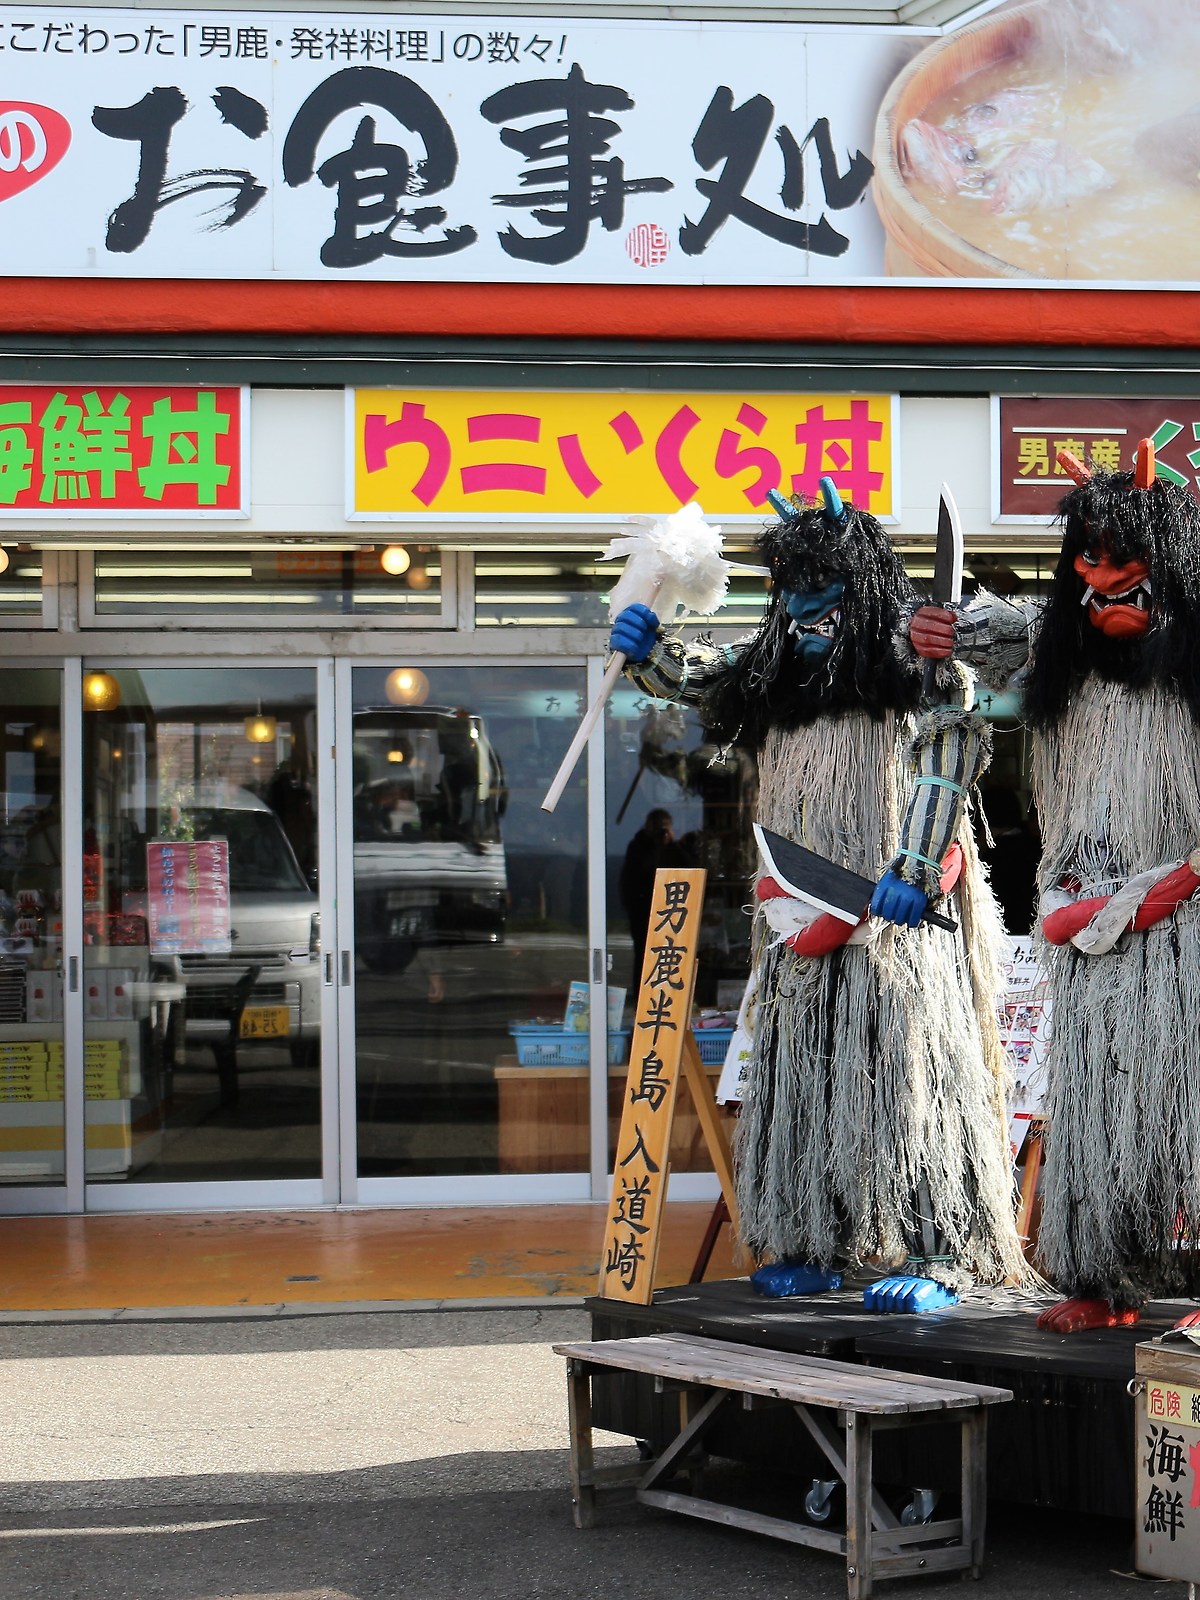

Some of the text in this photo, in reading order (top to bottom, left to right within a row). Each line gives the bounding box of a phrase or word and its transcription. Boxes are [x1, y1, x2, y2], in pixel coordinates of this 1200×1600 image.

[0, 22, 567, 64] こだわった「男鹿・発祥料理」の数々!
[92, 63, 875, 268] お食事処
[364, 400, 884, 510] ウニいくら丼
[1150, 1388, 1182, 1418] 危険
[1144, 1424, 1187, 1542] 海鮮
